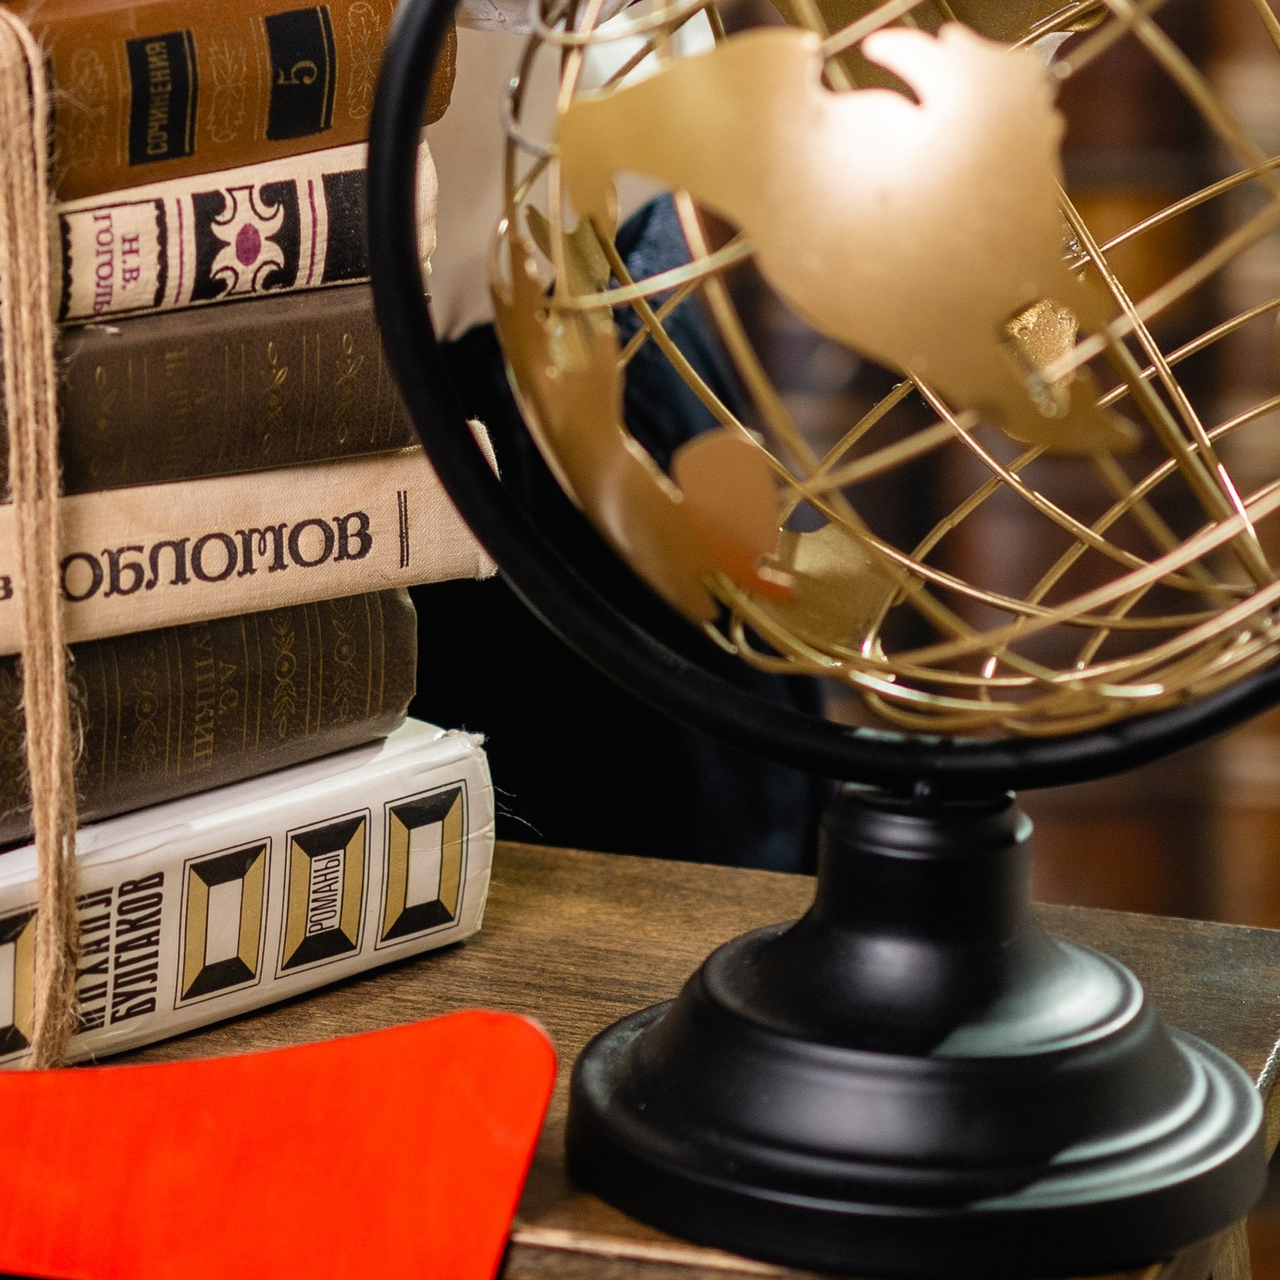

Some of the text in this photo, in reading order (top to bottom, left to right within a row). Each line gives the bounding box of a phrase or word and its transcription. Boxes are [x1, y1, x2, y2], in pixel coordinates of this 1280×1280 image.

[146, 40, 170, 156] СОЧИНЕНИЯ
[277, 58, 318, 88] 5
[93, 212, 116, 316] ГОГОЛЬ
[121, 233, 141, 292] Н.В.
[60, 510, 374, 603] ОБЛОМОВ
[192, 621, 217, 770] УШКИН
[308, 852, 341, 936] РОМАНЫ
[110, 871, 164, 1026] БУЛГАКОВ
